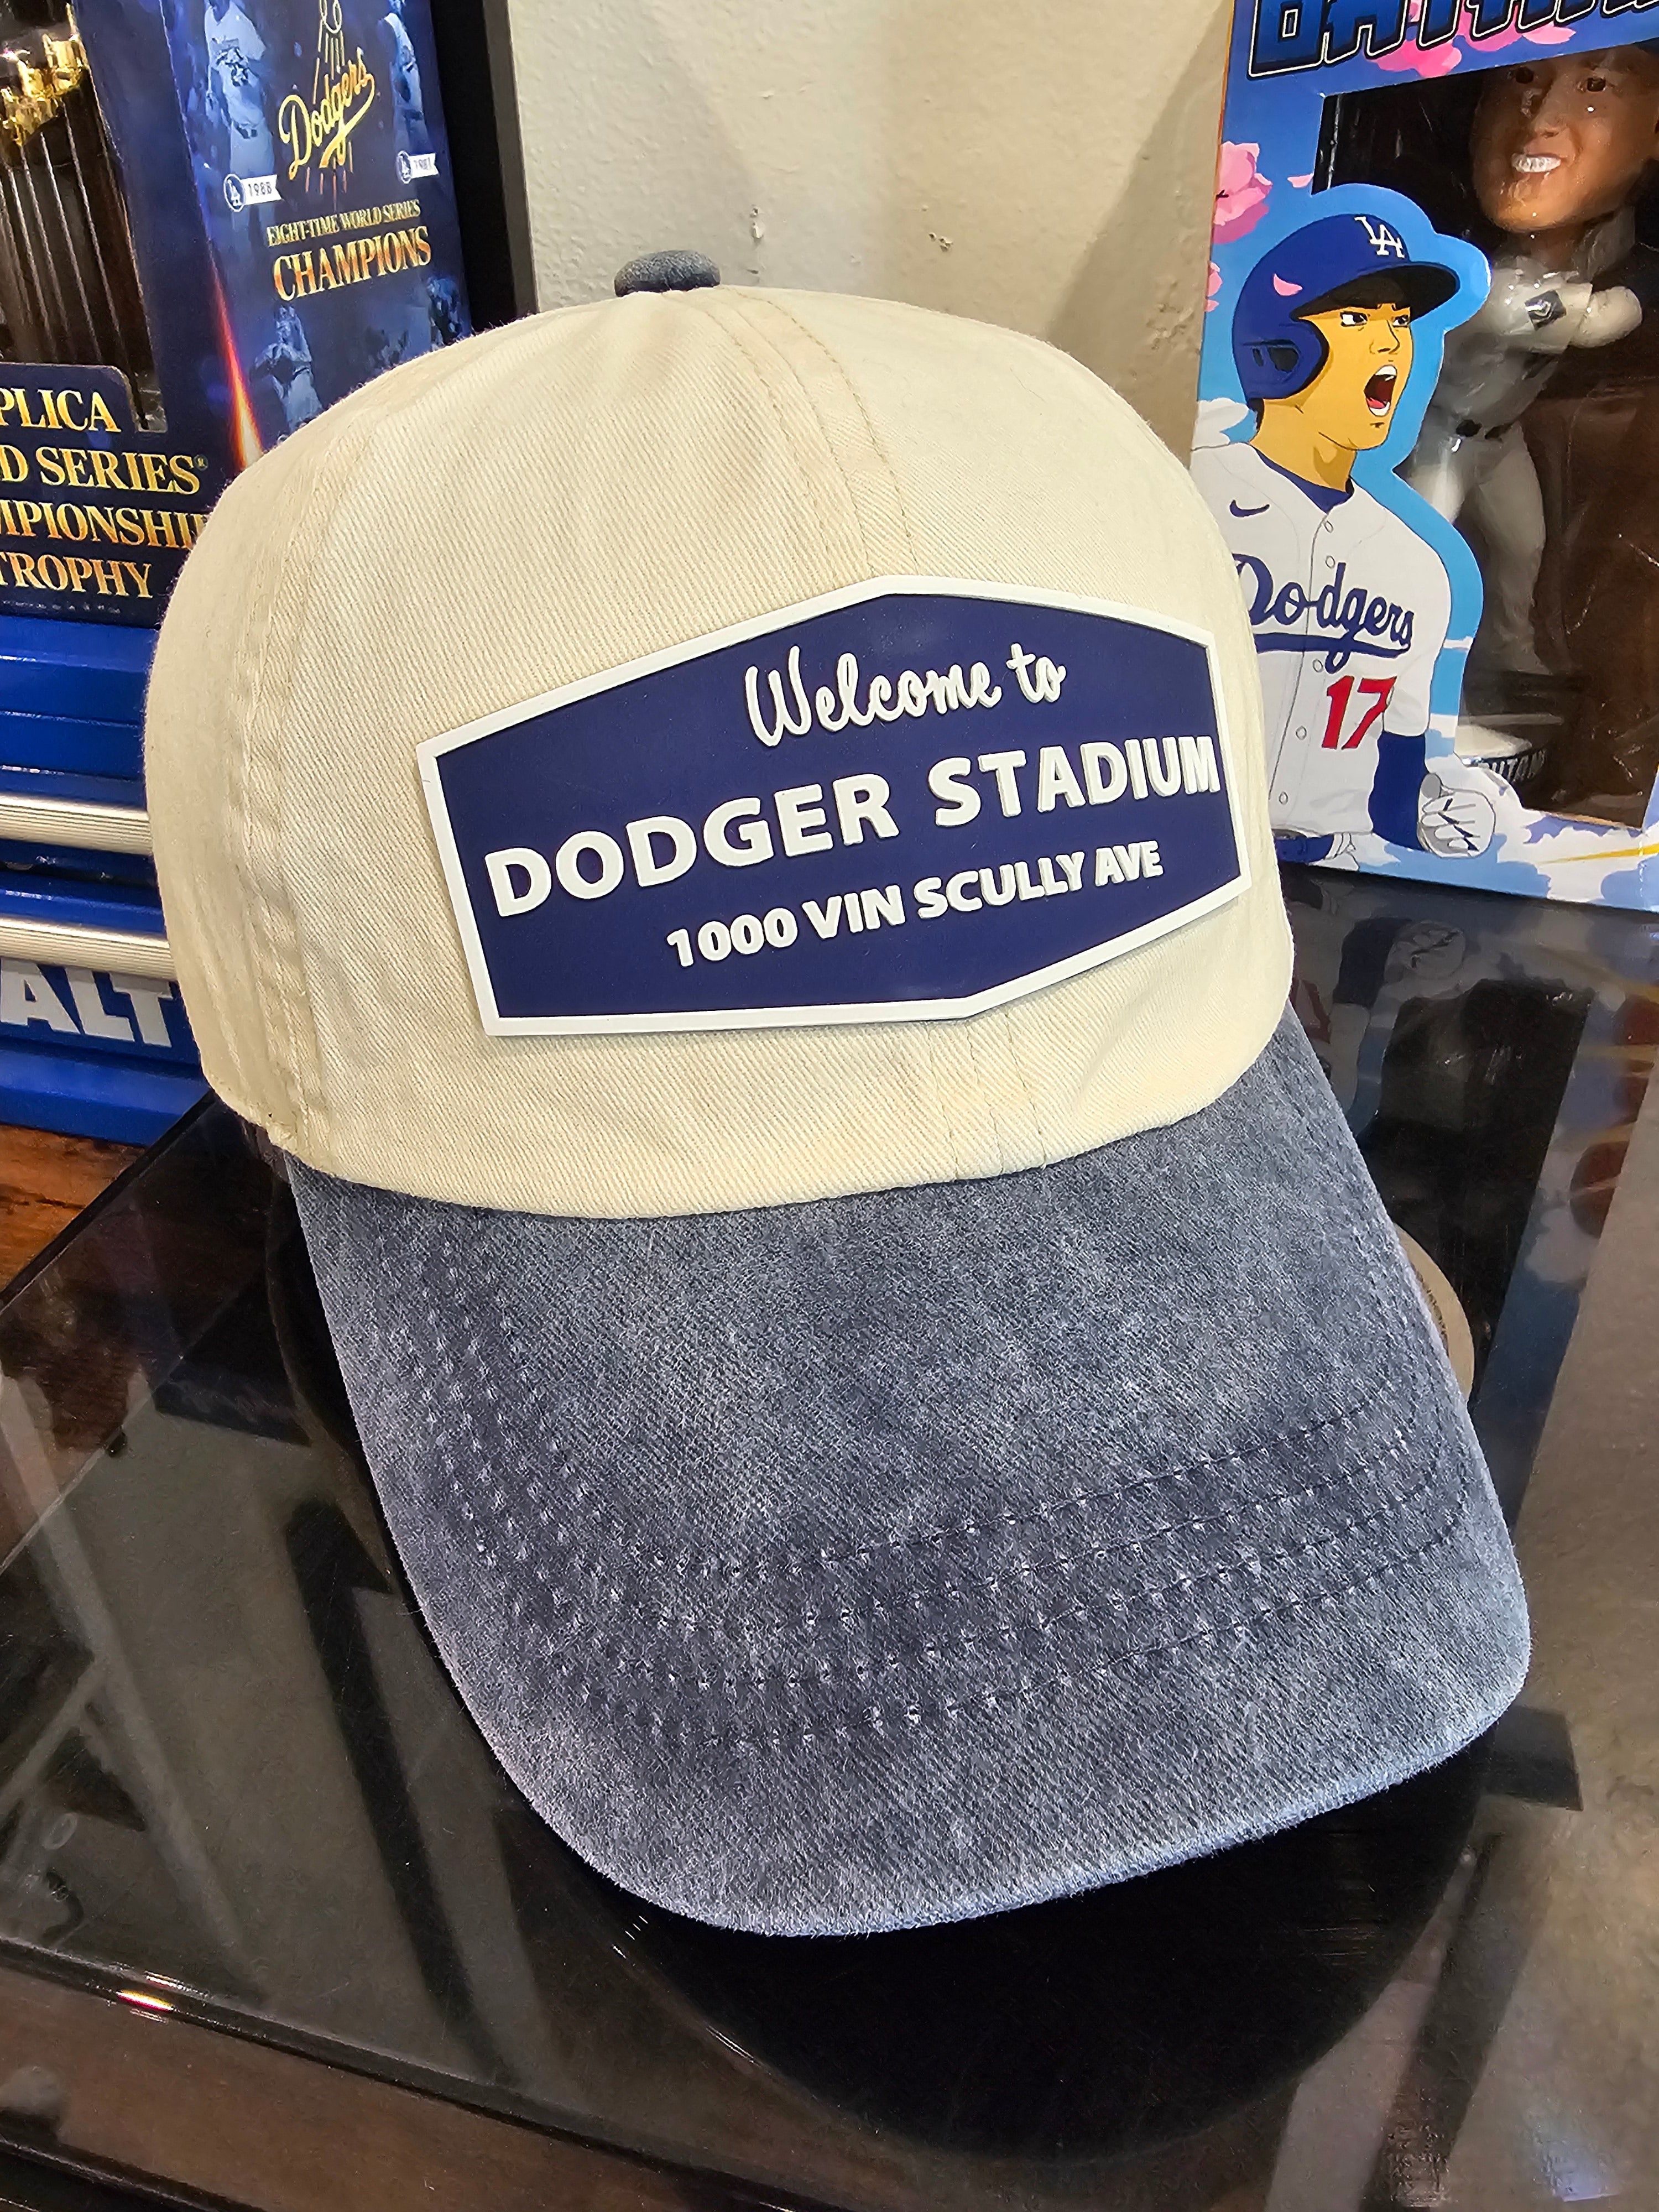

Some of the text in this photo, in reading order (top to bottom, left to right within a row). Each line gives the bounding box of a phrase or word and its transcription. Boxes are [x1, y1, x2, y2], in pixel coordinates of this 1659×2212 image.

[278, 46, 375, 181] Dodgers
[248, 181, 272, 196] 1988
[267, 199, 421, 247] EIGHT-TIME WORLD SERIES
[273, 226, 431, 301] CHAMPIONS
[1354, 216, 1405, 258] LA
[1231, 553, 1415, 674] Dodgers
[745, 643, 1066, 747] Welcome to
[1322, 675, 1397, 750] 17
[484, 735, 1220, 917] DODGER STADIUM
[667, 840, 1164, 967] 1000 VIN SCULLY AVE
[0, 956, 173, 1048] ALT
